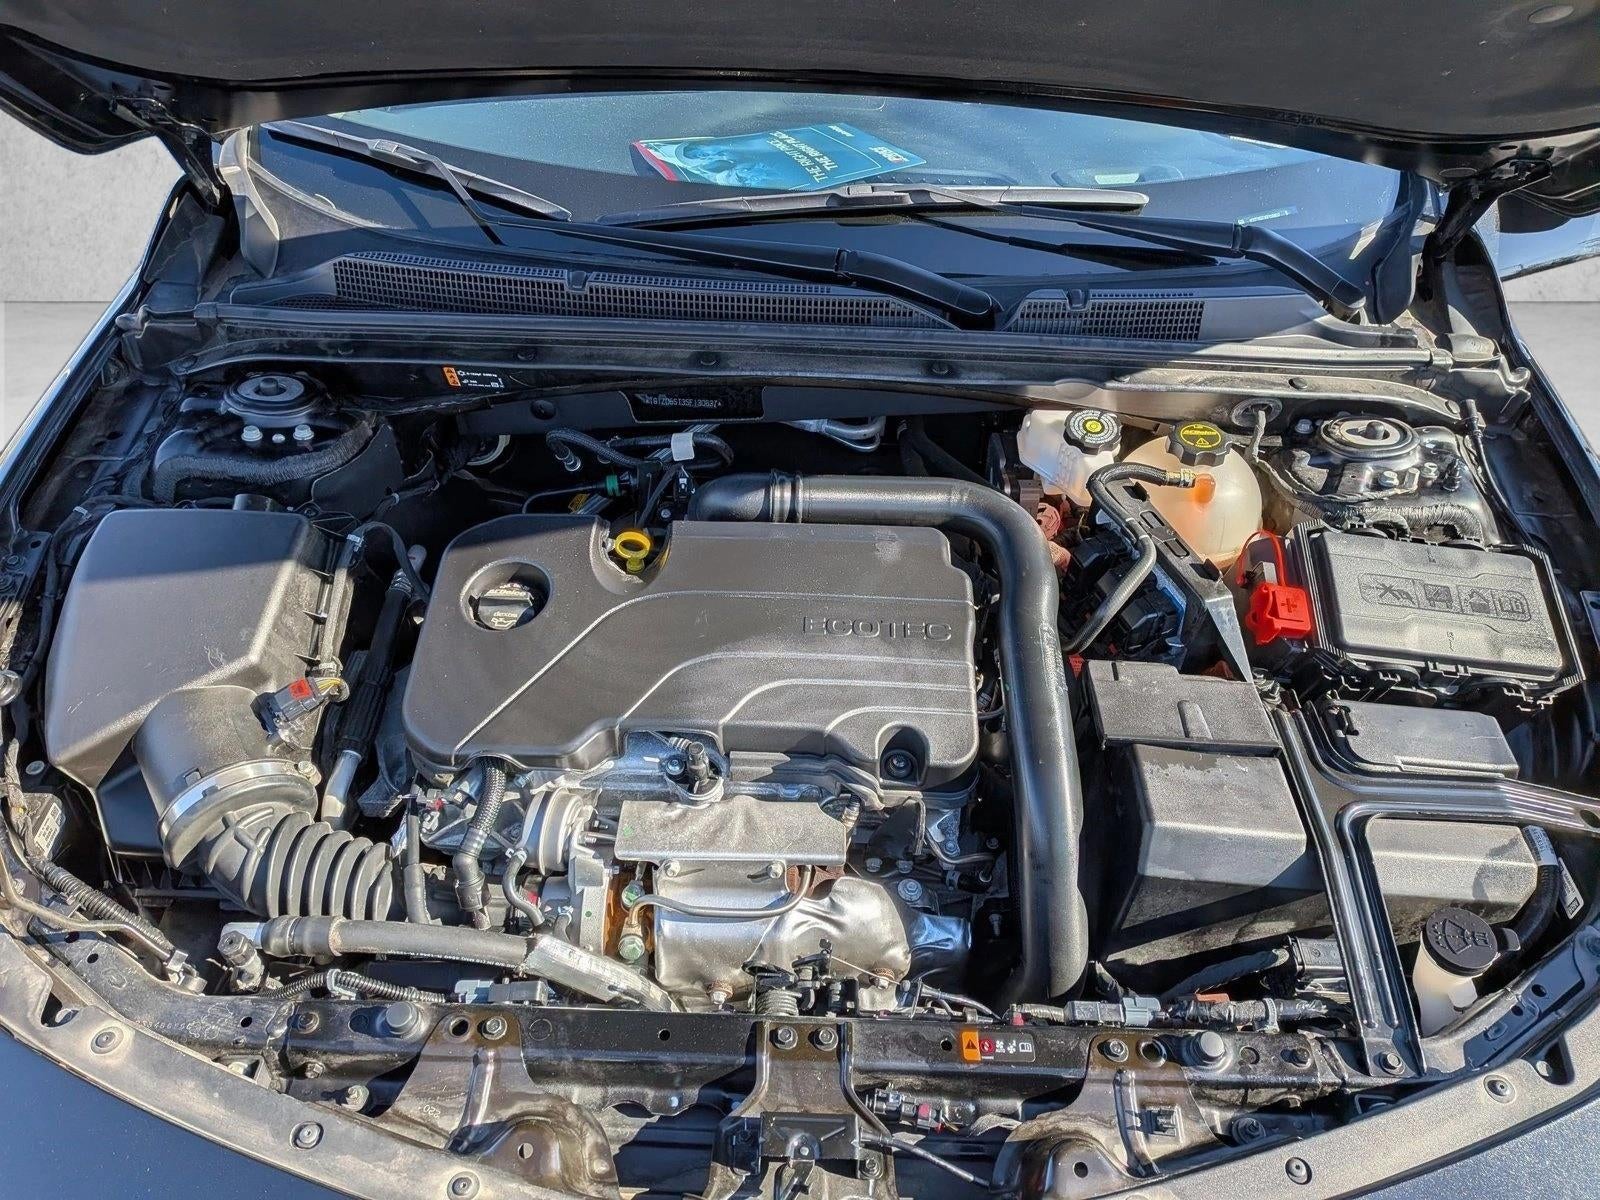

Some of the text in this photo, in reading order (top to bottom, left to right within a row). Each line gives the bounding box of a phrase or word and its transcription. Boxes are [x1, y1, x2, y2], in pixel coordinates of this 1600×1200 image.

[814, 156, 838, 171] THE
[804, 165, 828, 183] THE
[802, 616, 952, 642] ECOTEC
